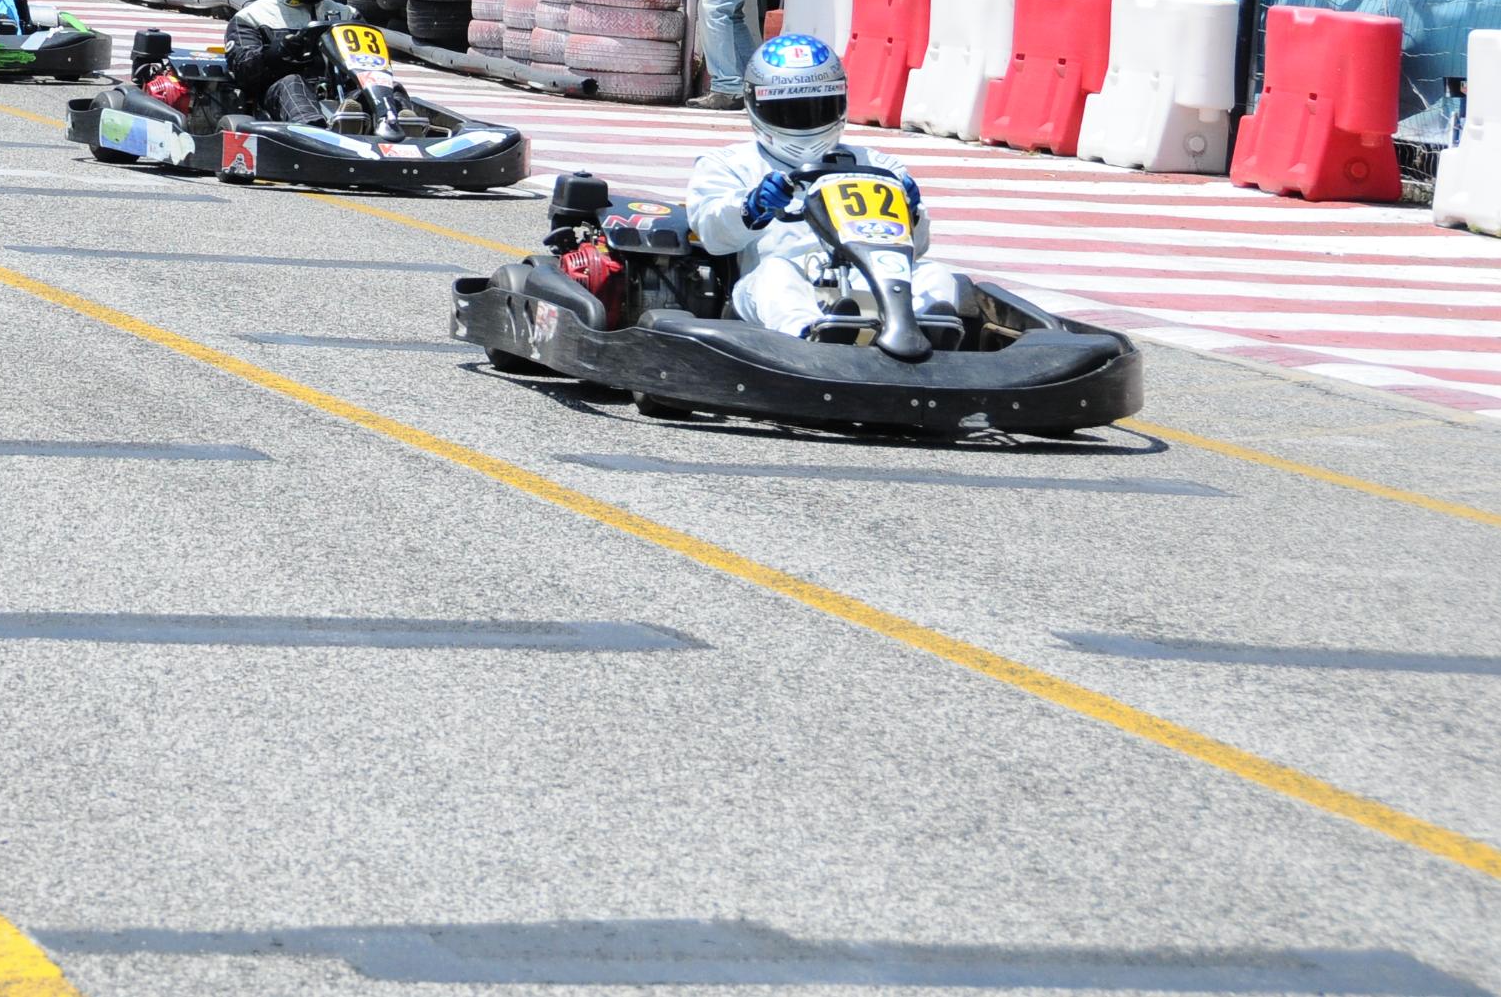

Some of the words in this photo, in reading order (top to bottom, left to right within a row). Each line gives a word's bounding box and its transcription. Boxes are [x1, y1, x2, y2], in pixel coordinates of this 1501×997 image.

[342, 28, 381, 55] 93
[771, 72, 829, 84] PlayStation
[786, 85, 822, 95] KARTING
[838, 183, 900, 219] 52
